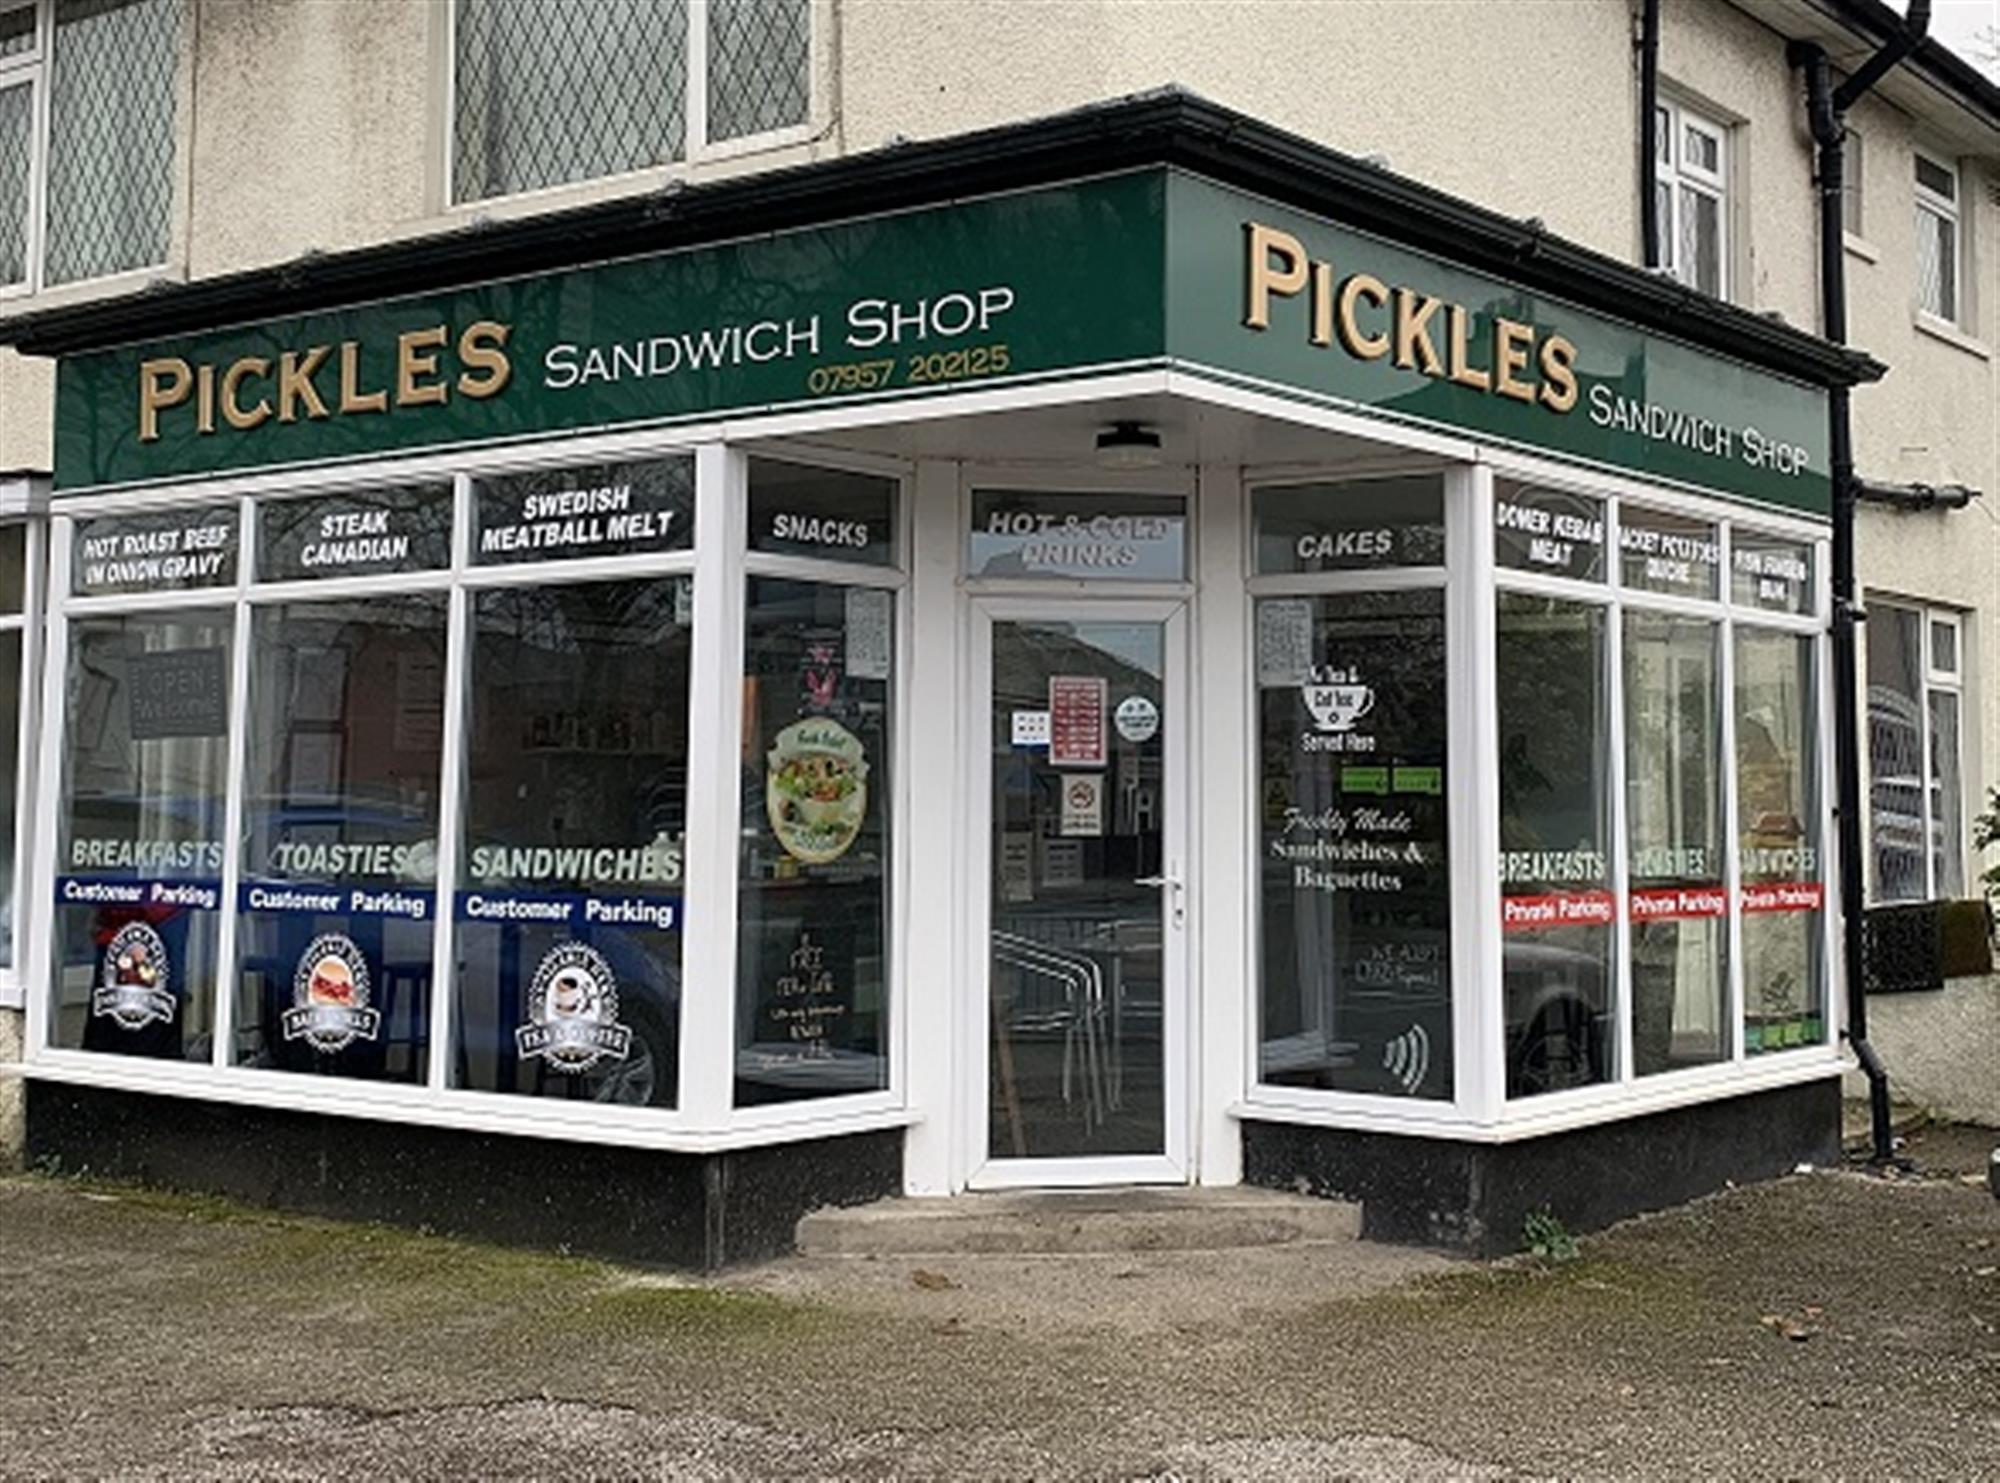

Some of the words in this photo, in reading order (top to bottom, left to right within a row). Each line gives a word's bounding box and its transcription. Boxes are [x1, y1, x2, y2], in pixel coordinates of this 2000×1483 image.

[1241, 221, 1578, 413] PICKLES
[545, 314, 820, 389] SANDWICH
[846, 286, 1015, 348] SHOP
[138, 320, 514, 443] PICKLES
[808, 358, 895, 395] 07957
[909, 345, 1010, 383] 202125
[1588, 381, 1733, 458] SANDWICH
[1741, 426, 1811, 478] SHOP
[523, 484, 630, 521] SWEDISH
[320, 510, 389, 537] STEAK
[481, 518, 603, 553] MEATBALL
[606, 511, 674, 541] MELT
[773, 513, 869, 549] SNACKS
[987, 511, 1055, 536] HOT
[1059, 515, 1080, 538] &
[1087, 514, 1170, 541] COLD
[1553, 515, 1604, 544] KEBAB
[84, 535, 119, 559] HOT
[123, 530, 180, 553] ROAST
[183, 525, 231, 550] BEEF
[300, 536, 408, 567] CANADIAN
[1297, 531, 1393, 560] CAKES
[1529, 539, 1574, 565] MEAT
[162, 552, 225, 579] GRAVY
[1021, 543, 1138, 572] DRINKS
[1646, 558, 1692, 583] QUICHE
[1300, 732, 1345, 752] Served
[1351, 807, 1413, 832] Made
[72, 839, 224, 869] BREAKFASTS
[277, 842, 411, 875] TOASTIES
[470, 845, 683, 881] SANDWICHES
[1271, 839, 1400, 861] Sandwiches
[1402, 842, 1426, 865] &
[1498, 850, 1606, 883] BREAKFASTS
[1294, 866, 1403, 892] Baguettes
[63, 880, 143, 901] Customer
[151, 883, 216, 909] Parking
[249, 889, 340, 912] Customer
[351, 892, 426, 917] Parking
[1632, 895, 1676, 915] Private
[1678, 892, 1725, 913] Parking
[1778, 887, 1821, 907] Parking
[466, 896, 573, 919] Customer
[586, 899, 673, 929] Parking
[1504, 900, 1556, 922] Private
[1558, 898, 1613, 921] Parking
